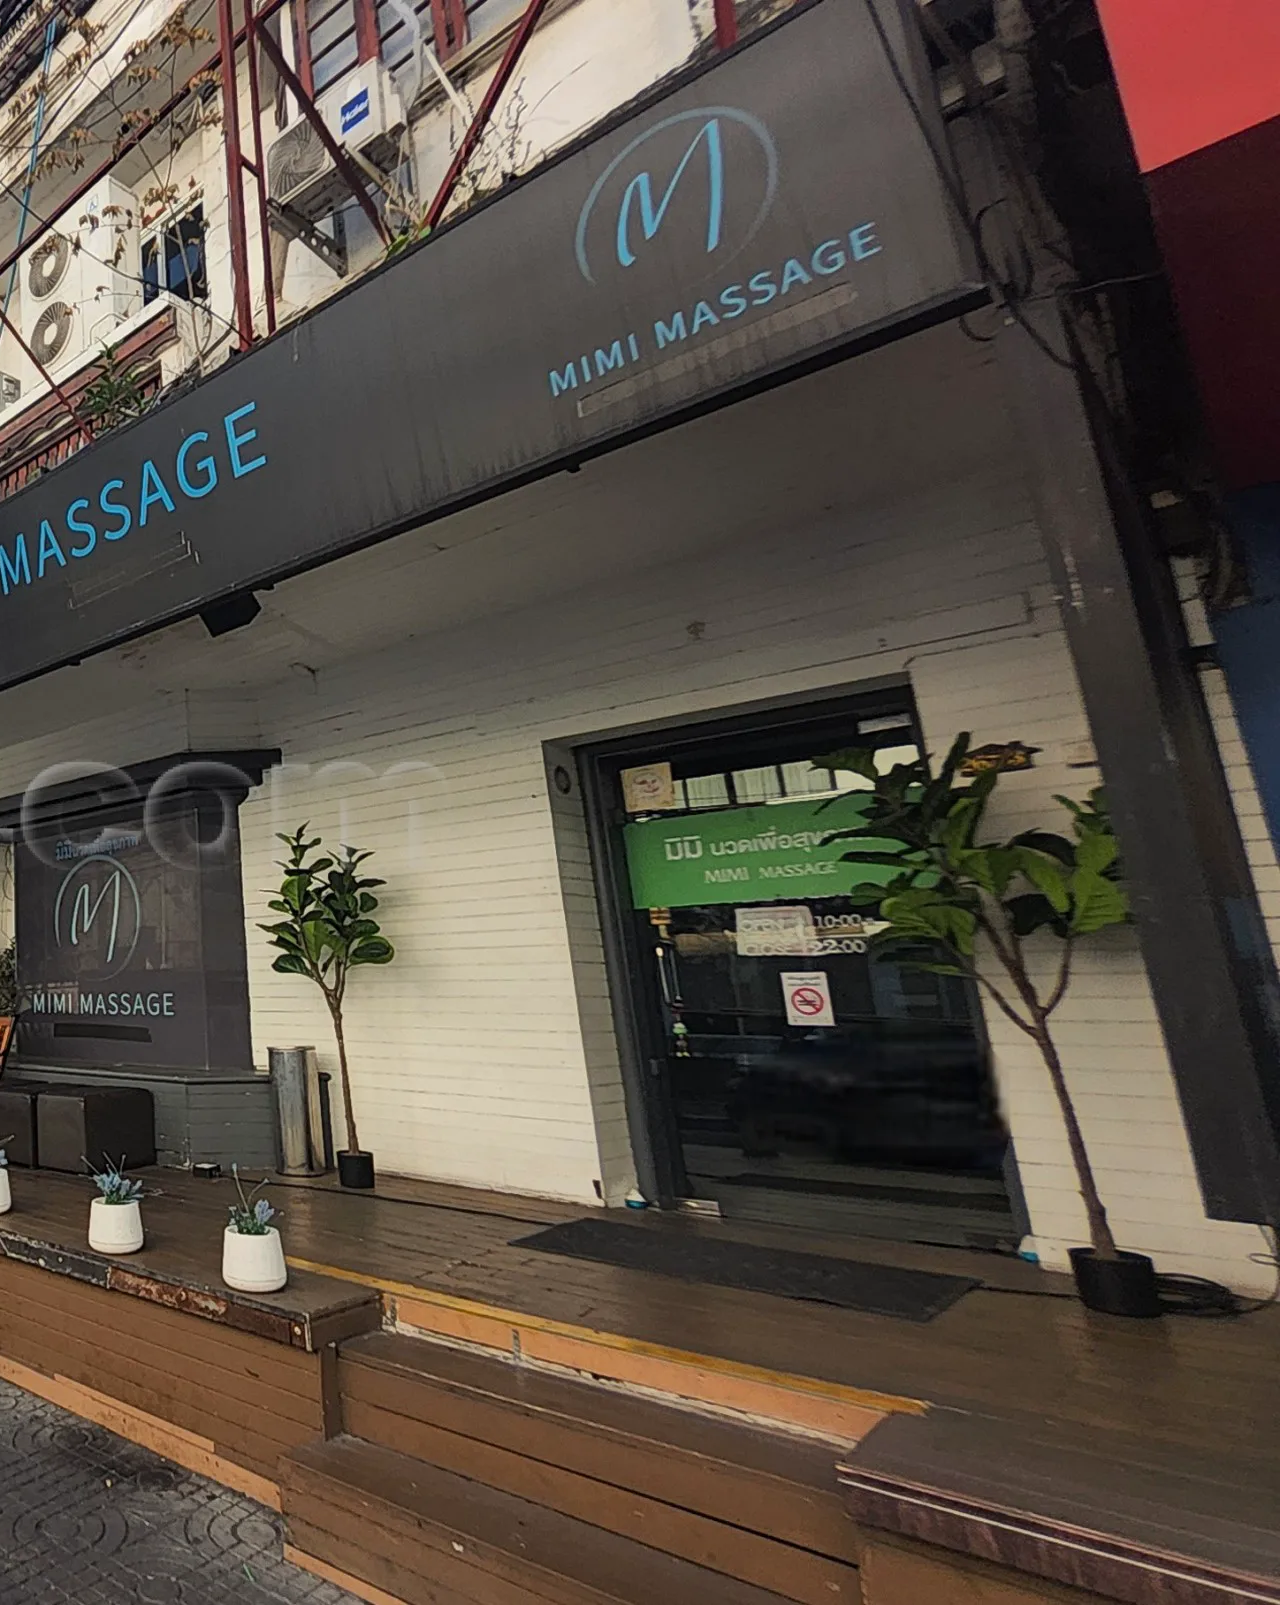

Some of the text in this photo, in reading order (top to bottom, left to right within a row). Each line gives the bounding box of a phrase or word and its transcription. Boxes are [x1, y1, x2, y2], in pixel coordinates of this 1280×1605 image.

[548, 221, 884, 397] MIMI MASSAGE
[704, 860, 839, 884] MIMI MASSAGE
[32, 992, 176, 1017] MIMI MASSAGE
